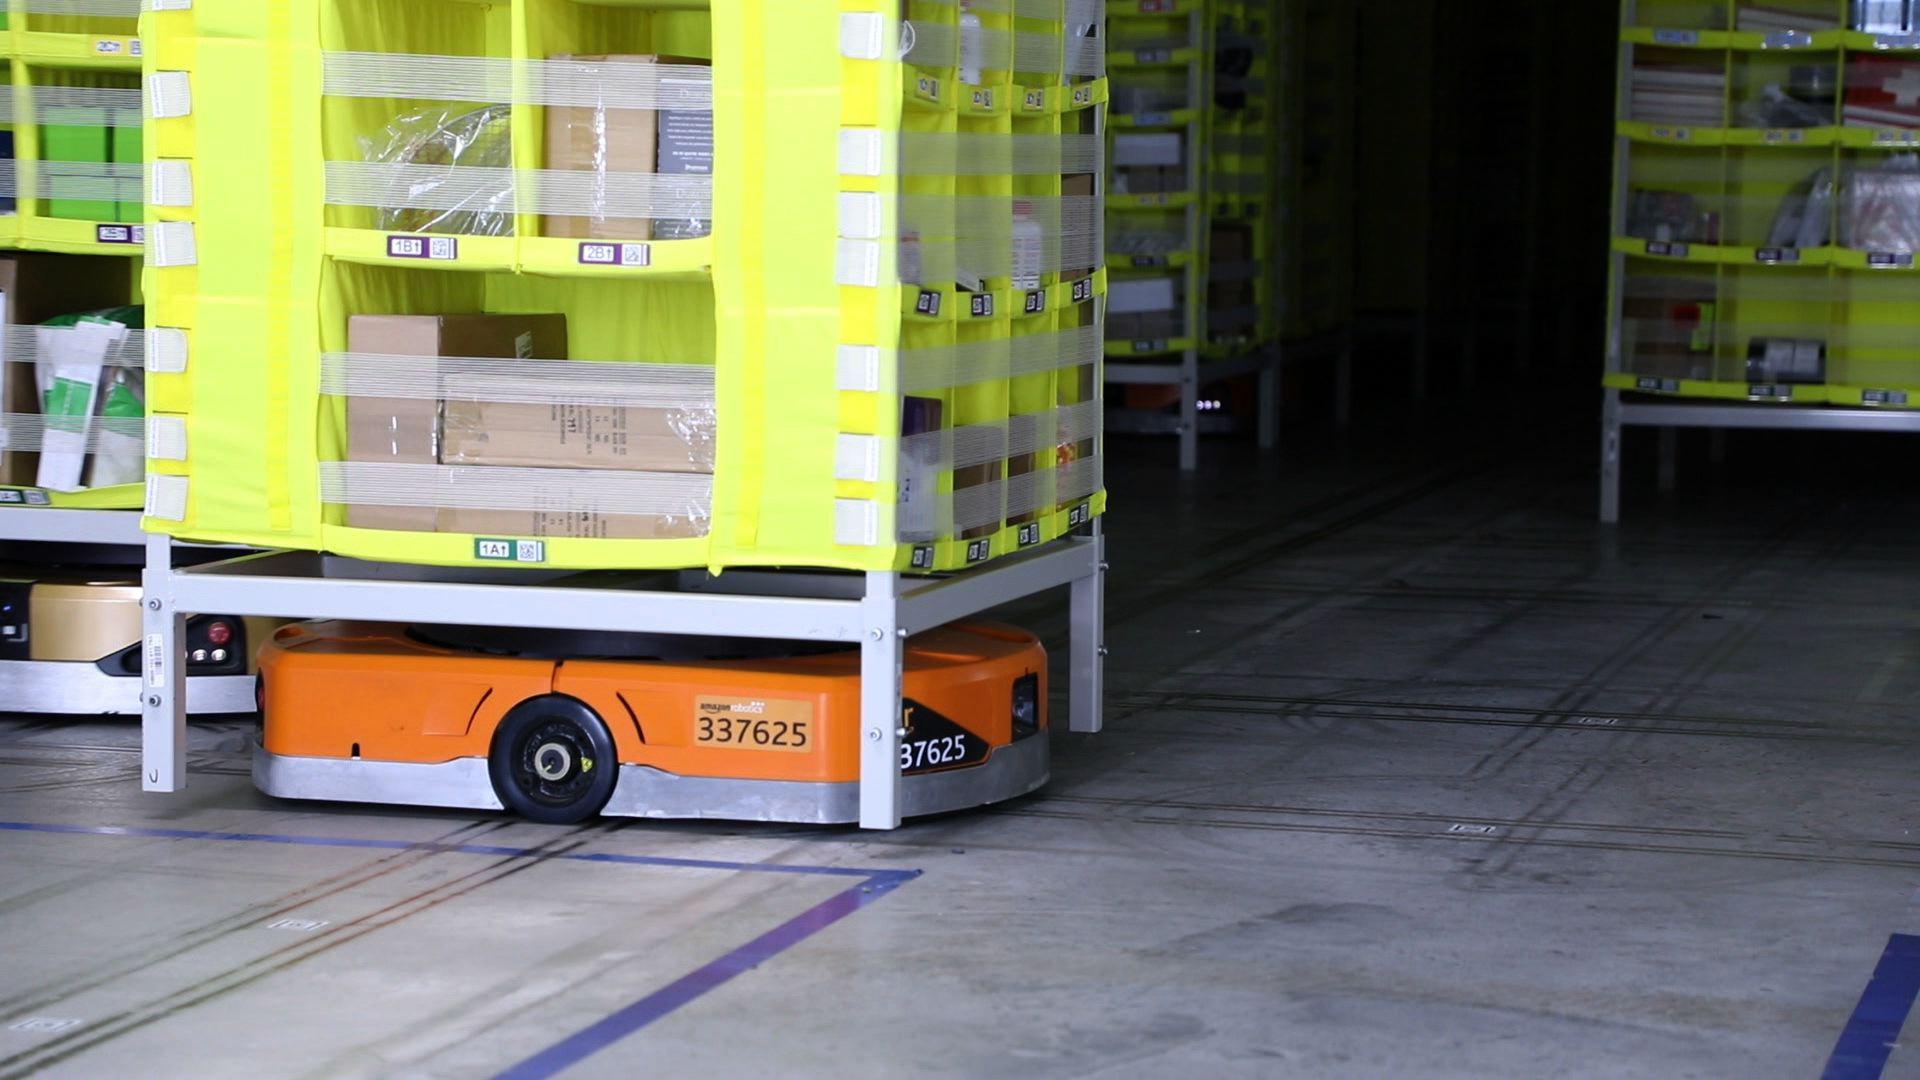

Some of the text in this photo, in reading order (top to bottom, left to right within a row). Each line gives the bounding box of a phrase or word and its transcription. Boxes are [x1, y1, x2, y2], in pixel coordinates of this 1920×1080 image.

[587, 246, 604, 259] 2B
[483, 544, 499, 554] 1A
[698, 717, 807, 747] 337625
